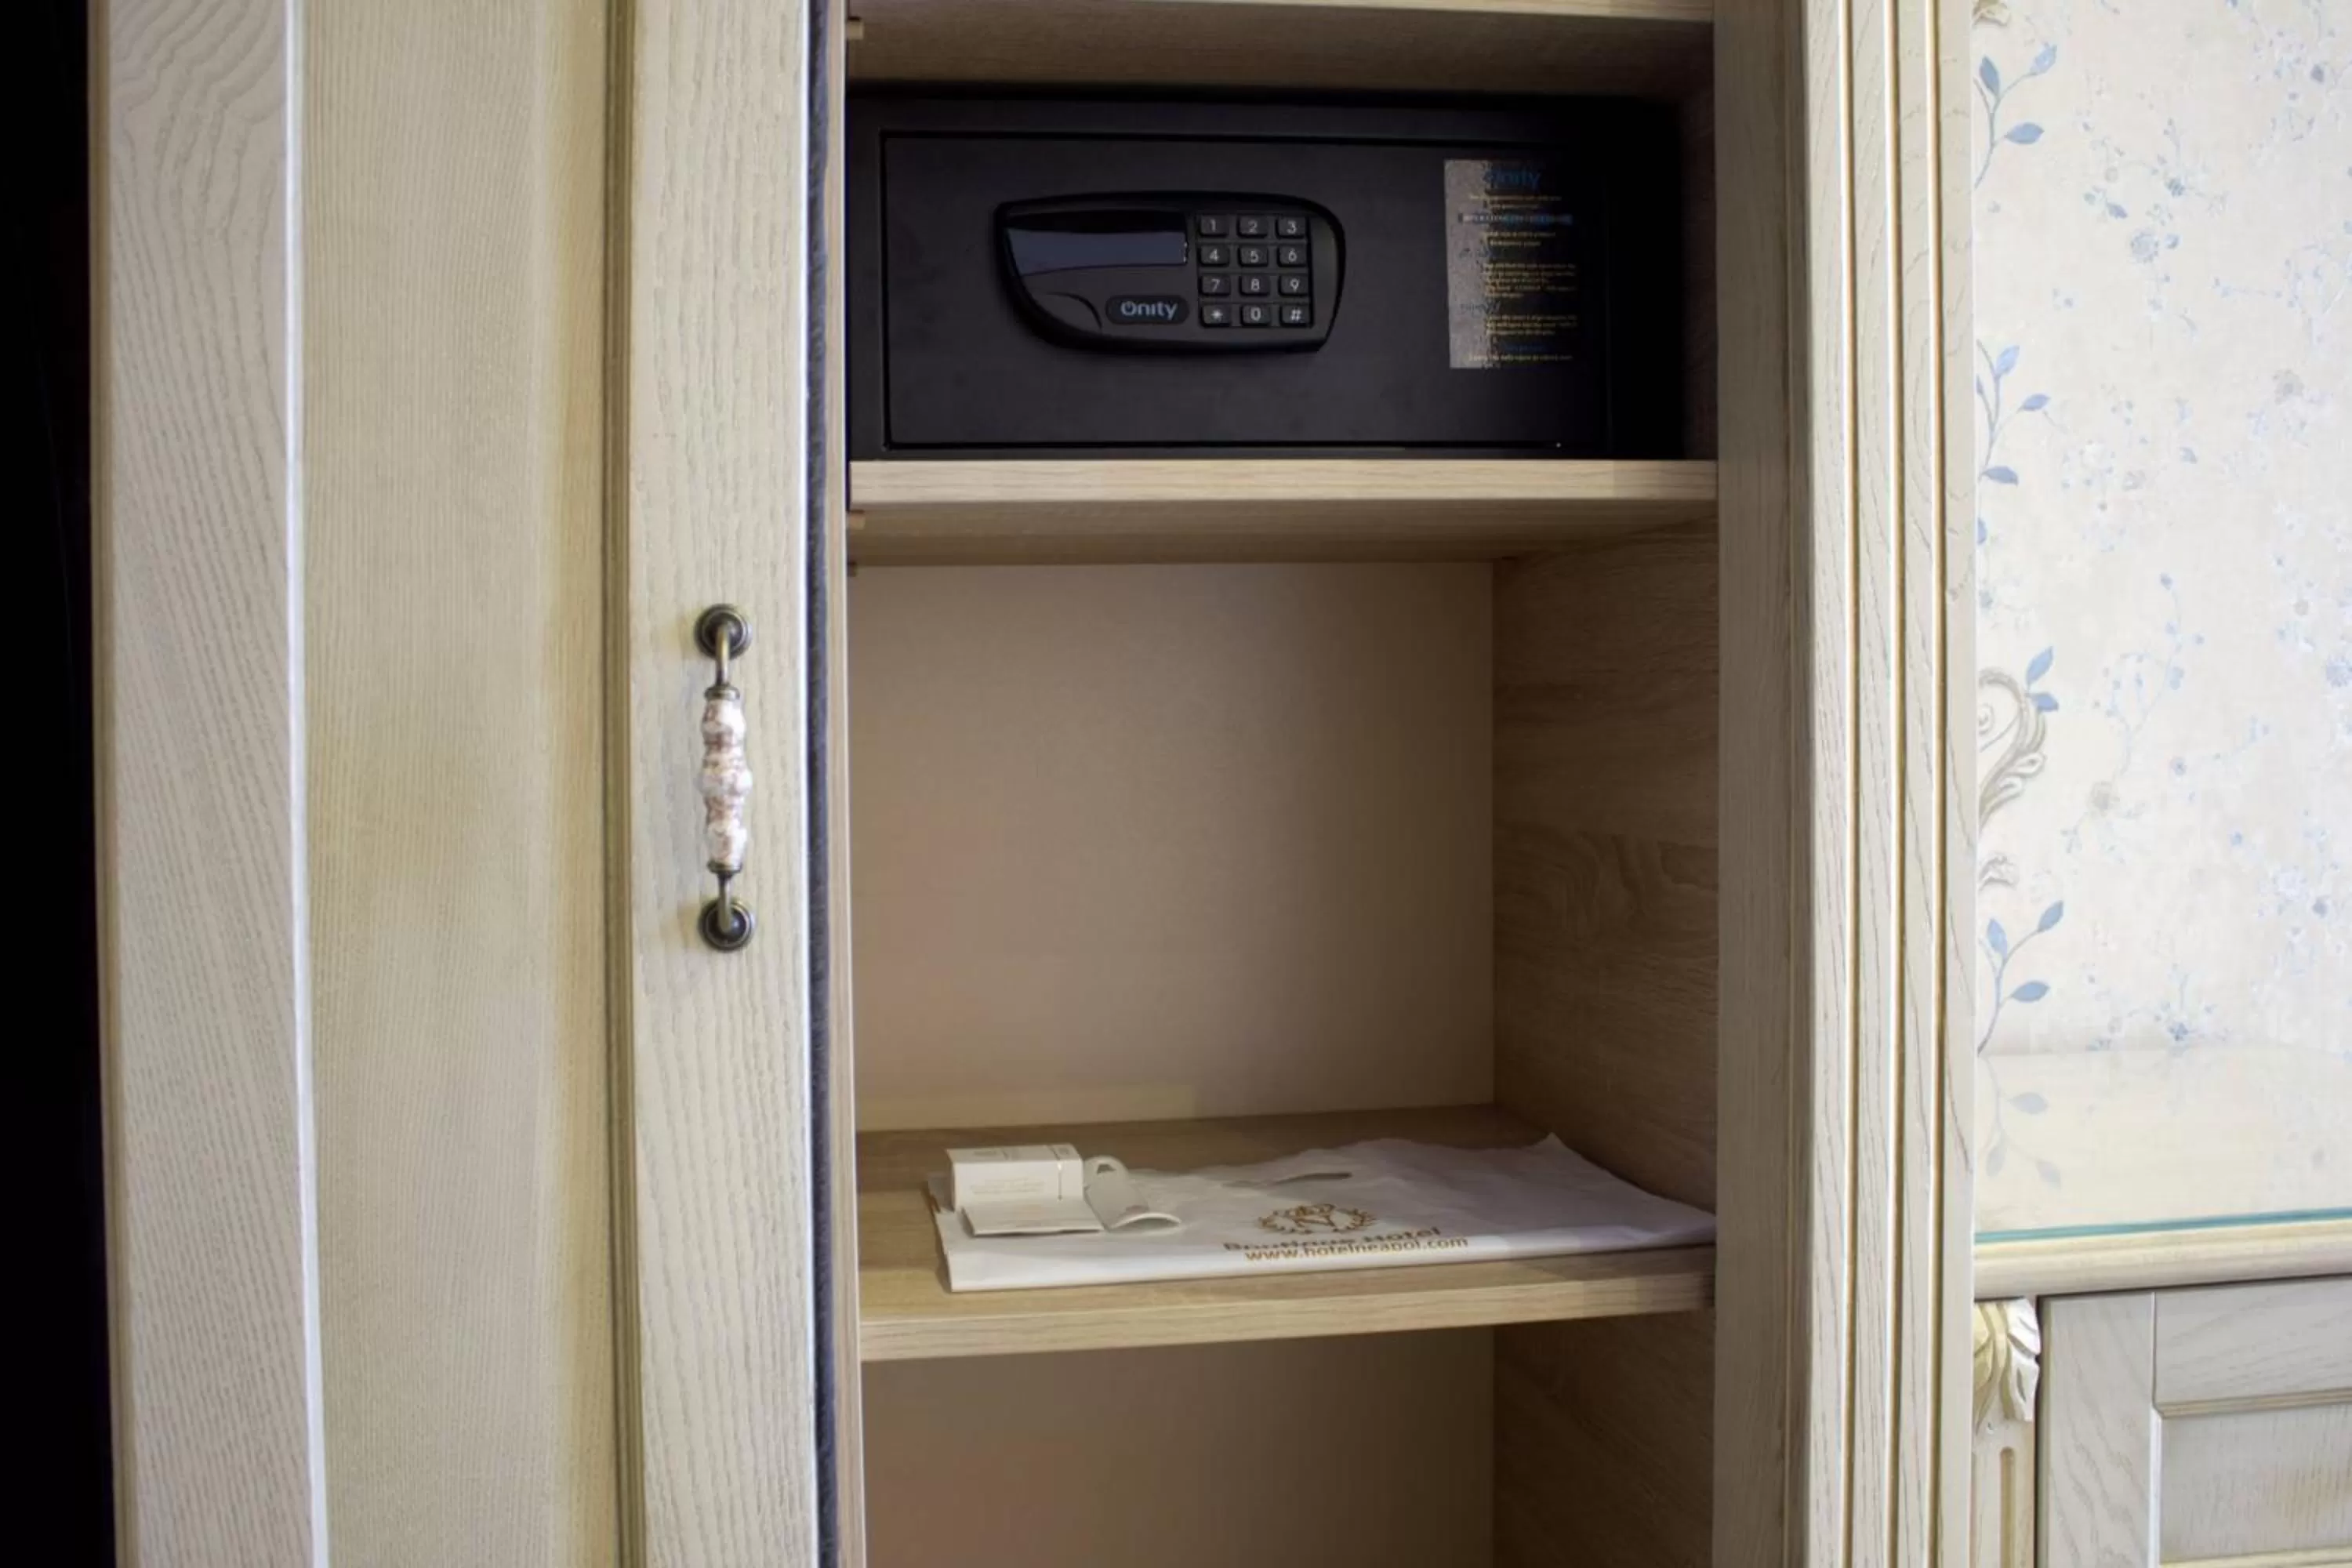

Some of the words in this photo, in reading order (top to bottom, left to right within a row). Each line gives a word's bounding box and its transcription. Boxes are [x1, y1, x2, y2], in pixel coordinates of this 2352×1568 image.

[1209, 218, 1217, 232] 1
[1247, 220, 1258, 234] 2
[1287, 220, 1298, 234] 3
[1209, 249, 1220, 262] 4
[1250, 250, 1259, 263] 5
[1287, 248, 1298, 262] 6
[1210, 278, 1221, 292] 7
[1250, 278, 1260, 292] 8
[1290, 278, 1300, 292] 9
[1120, 301, 1178, 321] Onity
[1250, 307, 1261, 321] 0
